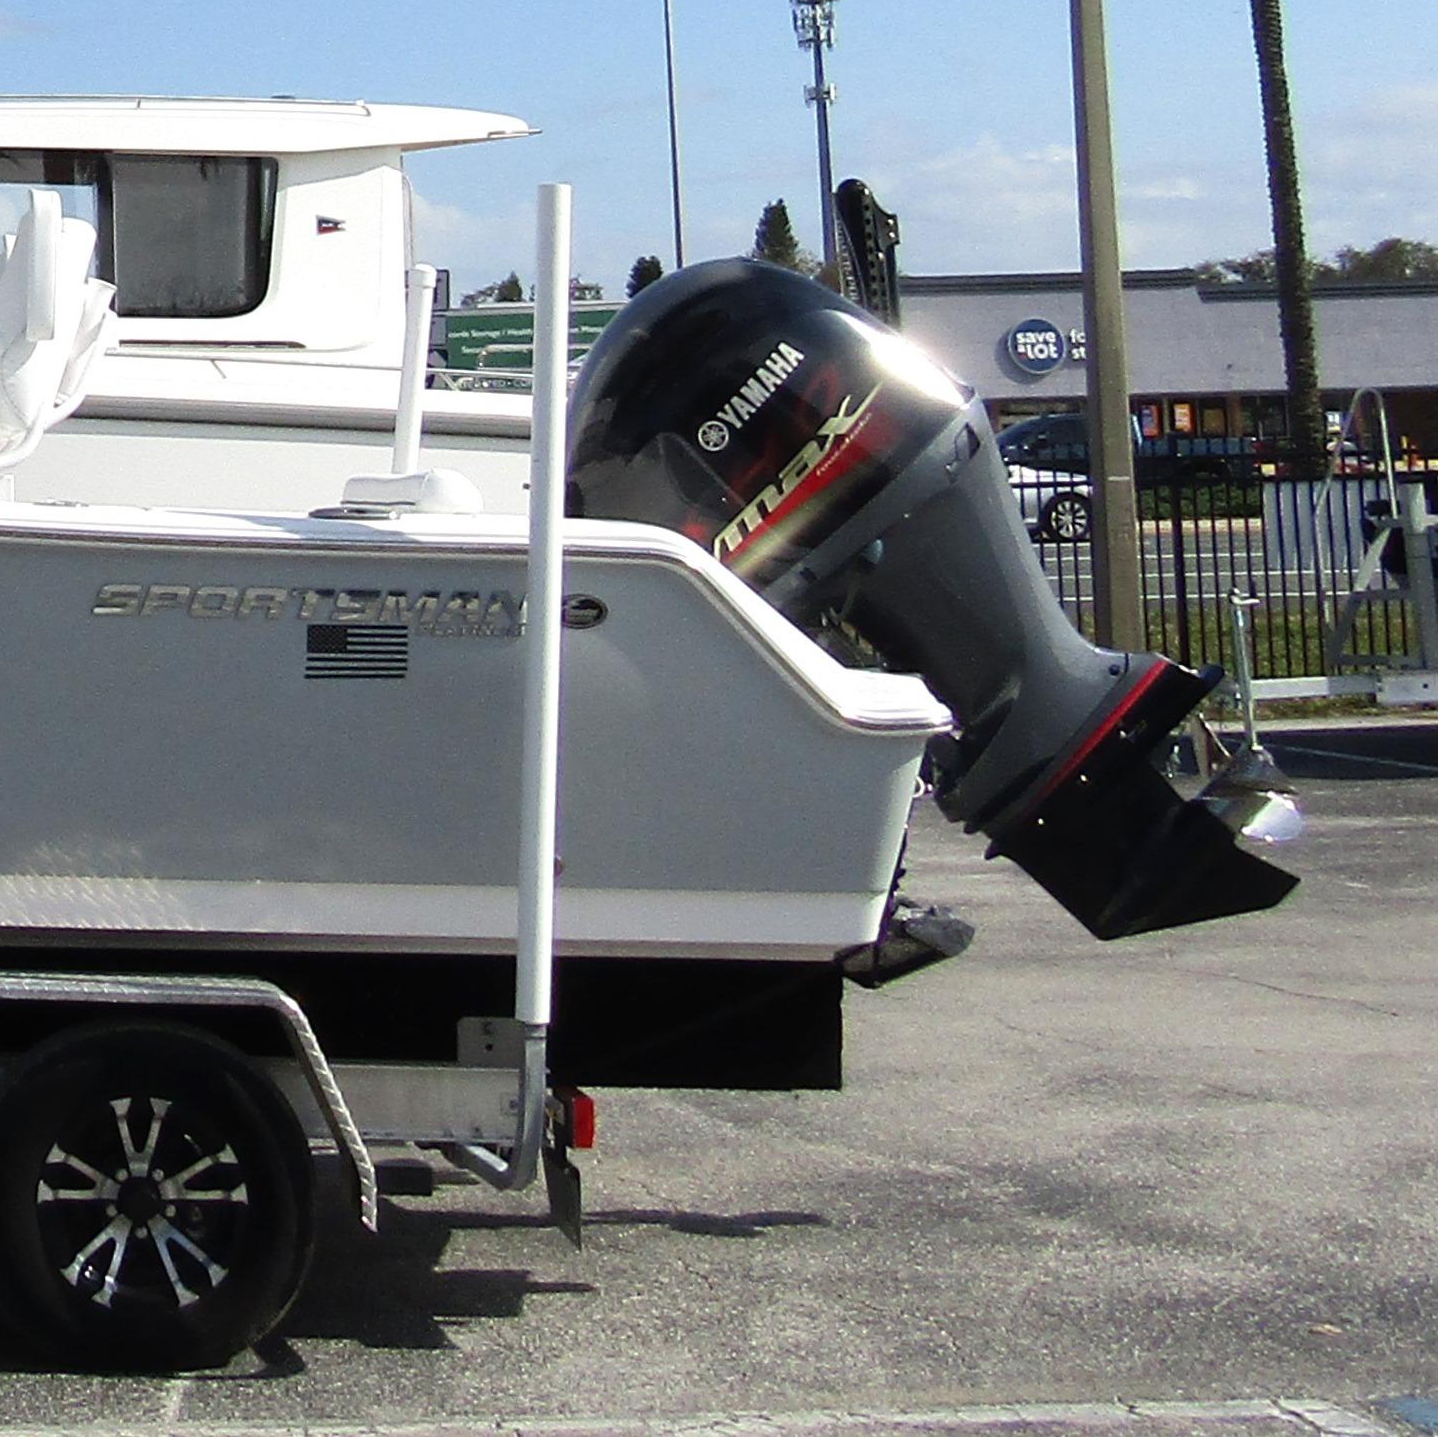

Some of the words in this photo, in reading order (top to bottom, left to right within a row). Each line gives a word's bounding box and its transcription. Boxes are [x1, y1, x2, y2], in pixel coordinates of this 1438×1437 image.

[1016, 331, 1056, 343] save
[717, 342, 805, 429] YAMAHA
[91, 583, 527, 623] SPORTSMAN
